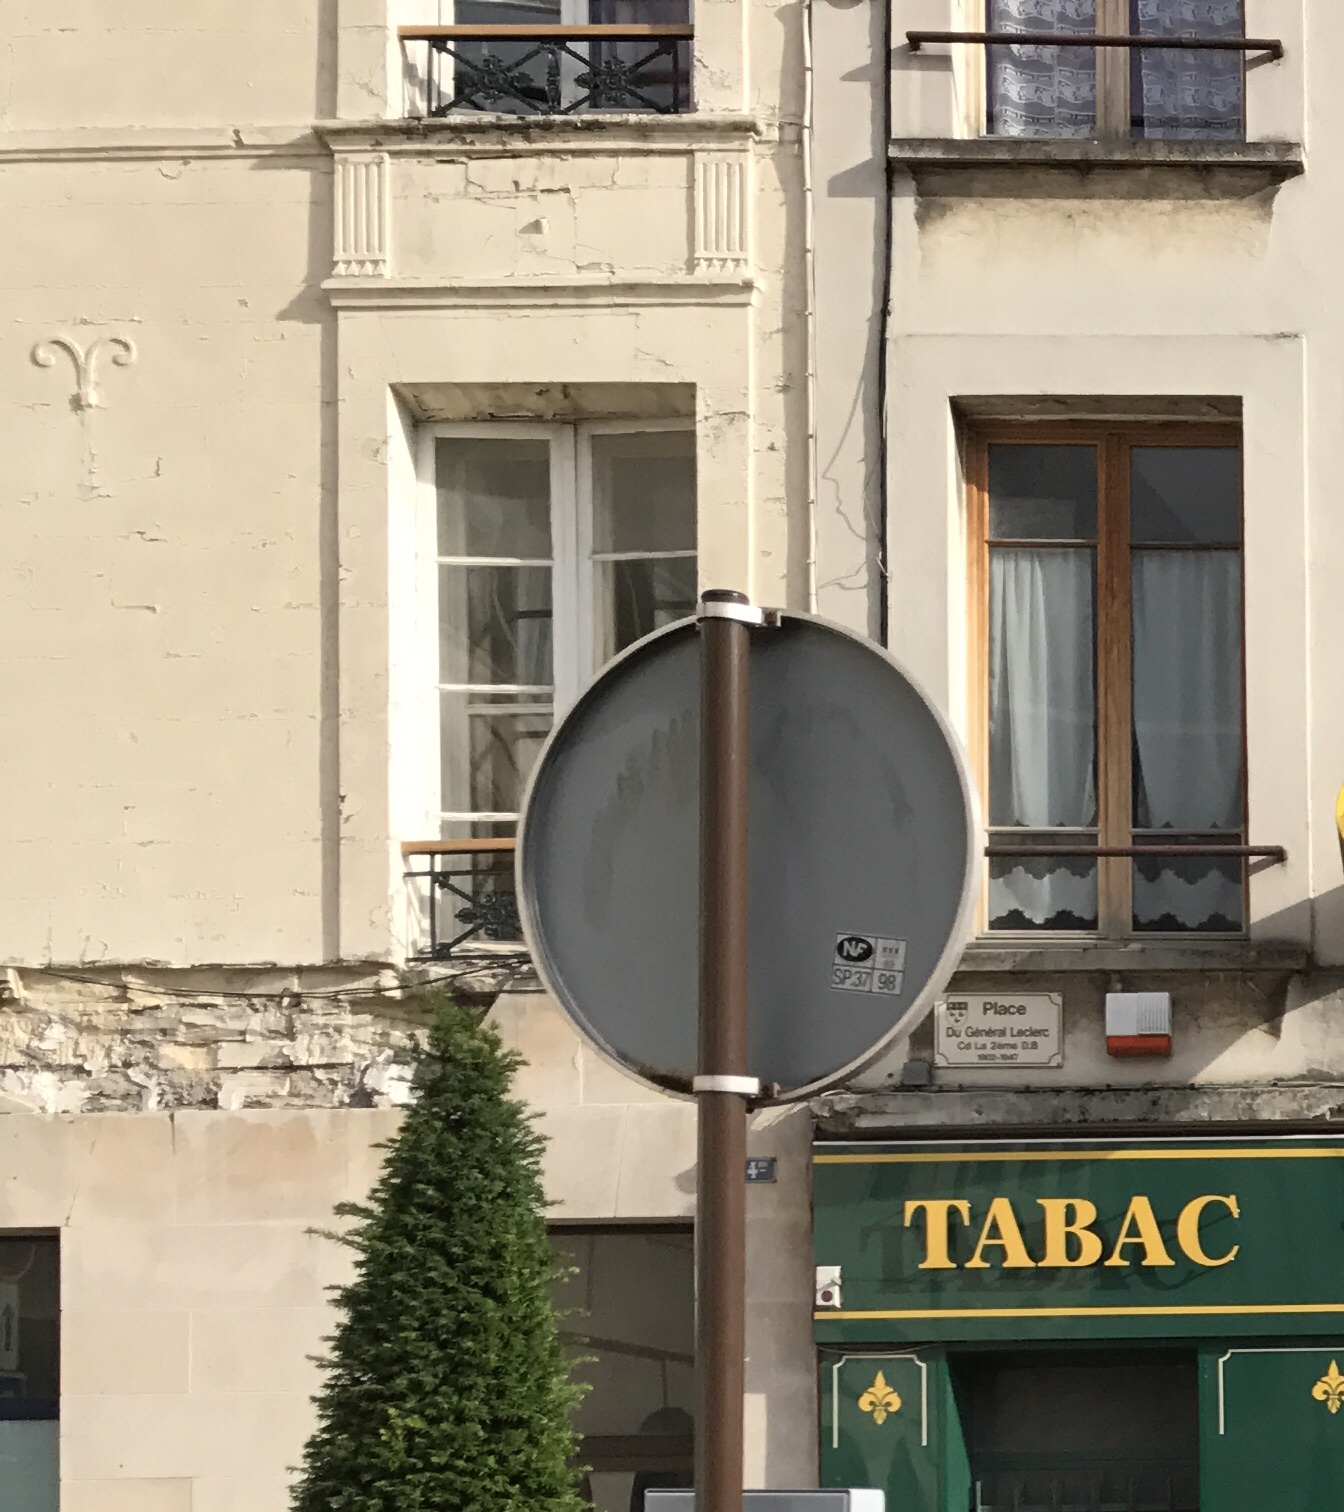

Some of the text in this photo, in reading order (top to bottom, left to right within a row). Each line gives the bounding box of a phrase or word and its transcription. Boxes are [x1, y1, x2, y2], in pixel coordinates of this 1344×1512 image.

[842, 940, 868, 958] NF
[877, 973, 897, 991] 98
[982, 1001, 1028, 1016] Place
[945, 1025, 1050, 1038] Du Général Leclerc
[974, 1041, 988, 1051] La
[903, 1194, 1242, 1270] TABAC
